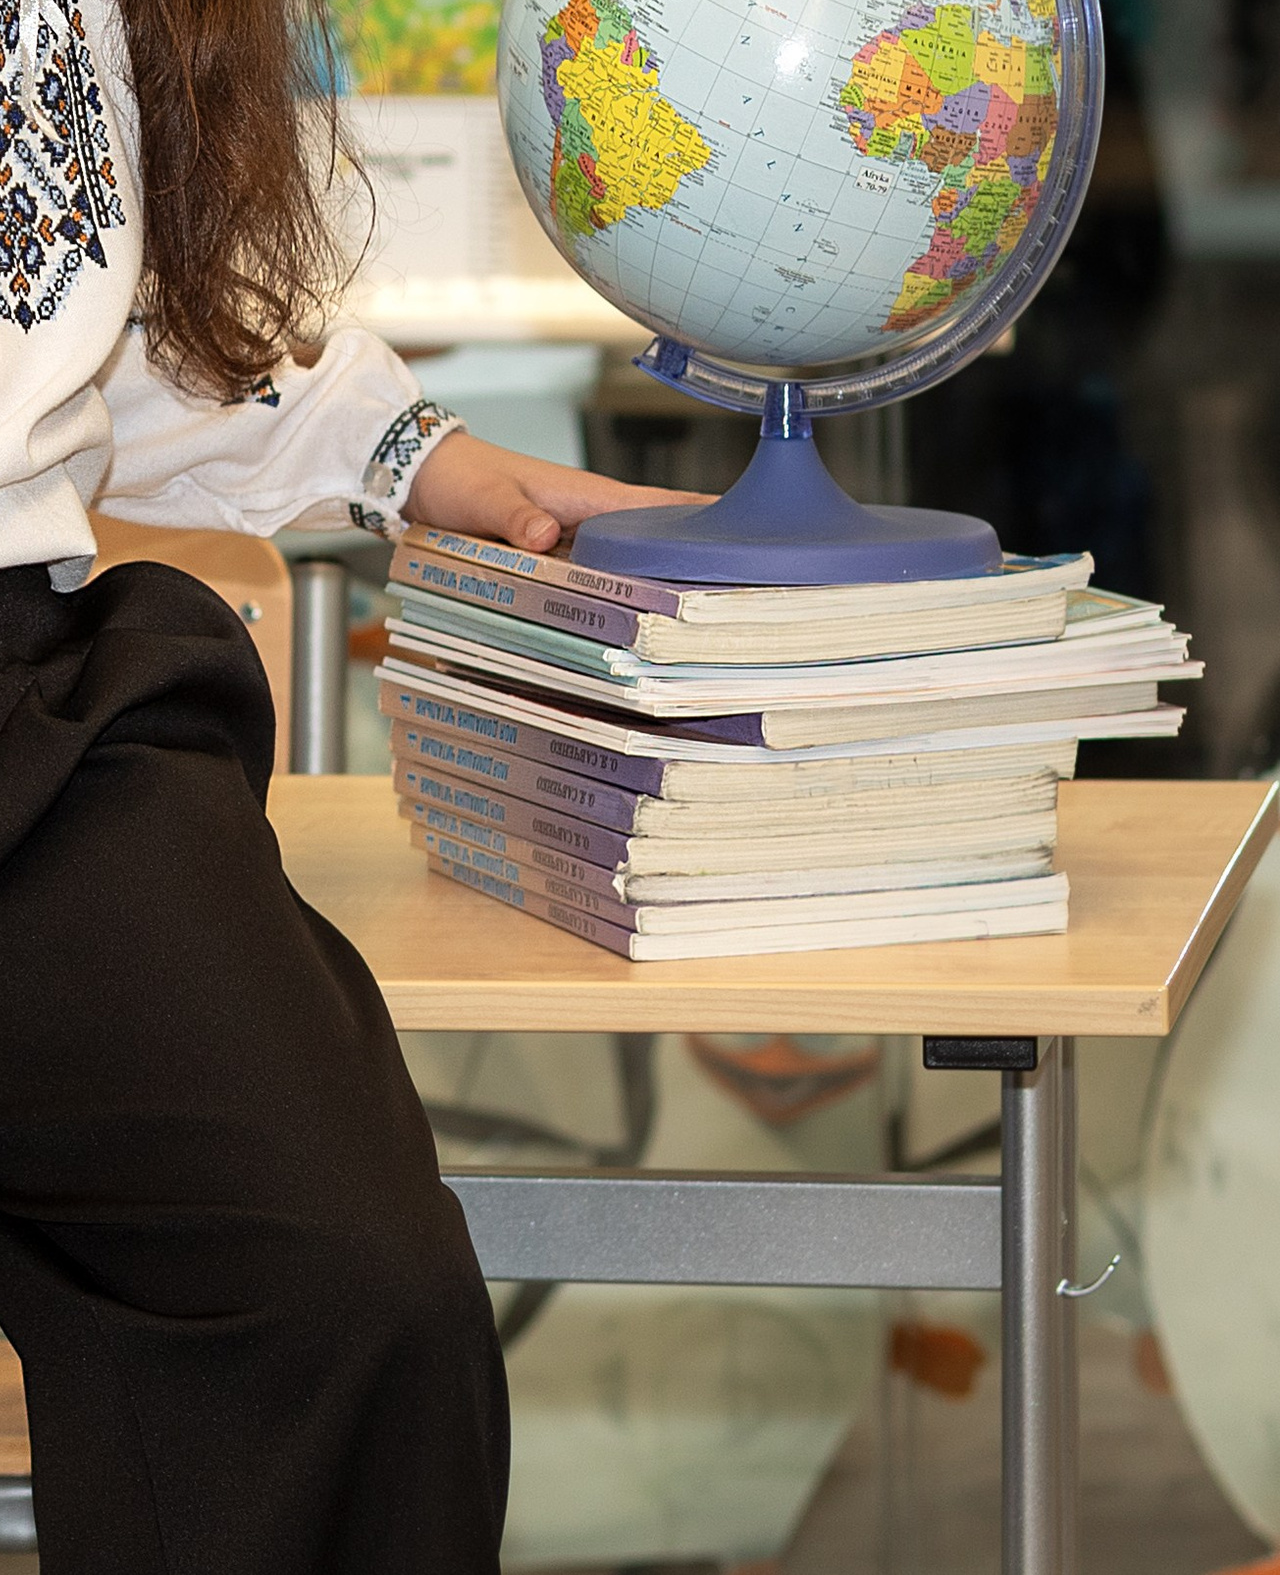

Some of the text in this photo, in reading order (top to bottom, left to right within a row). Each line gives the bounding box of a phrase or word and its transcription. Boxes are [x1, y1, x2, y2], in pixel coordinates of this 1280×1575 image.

[943, 104, 979, 118] NIGER
[591, 114, 660, 159] BRAZYLIA
[862, 169, 889, 183] Afryka
[866, 181, 888, 194] 70-79
[544, 599, 586, 624] САВЧЕНКО
[550, 740, 597, 766] САВЧЕНКО
